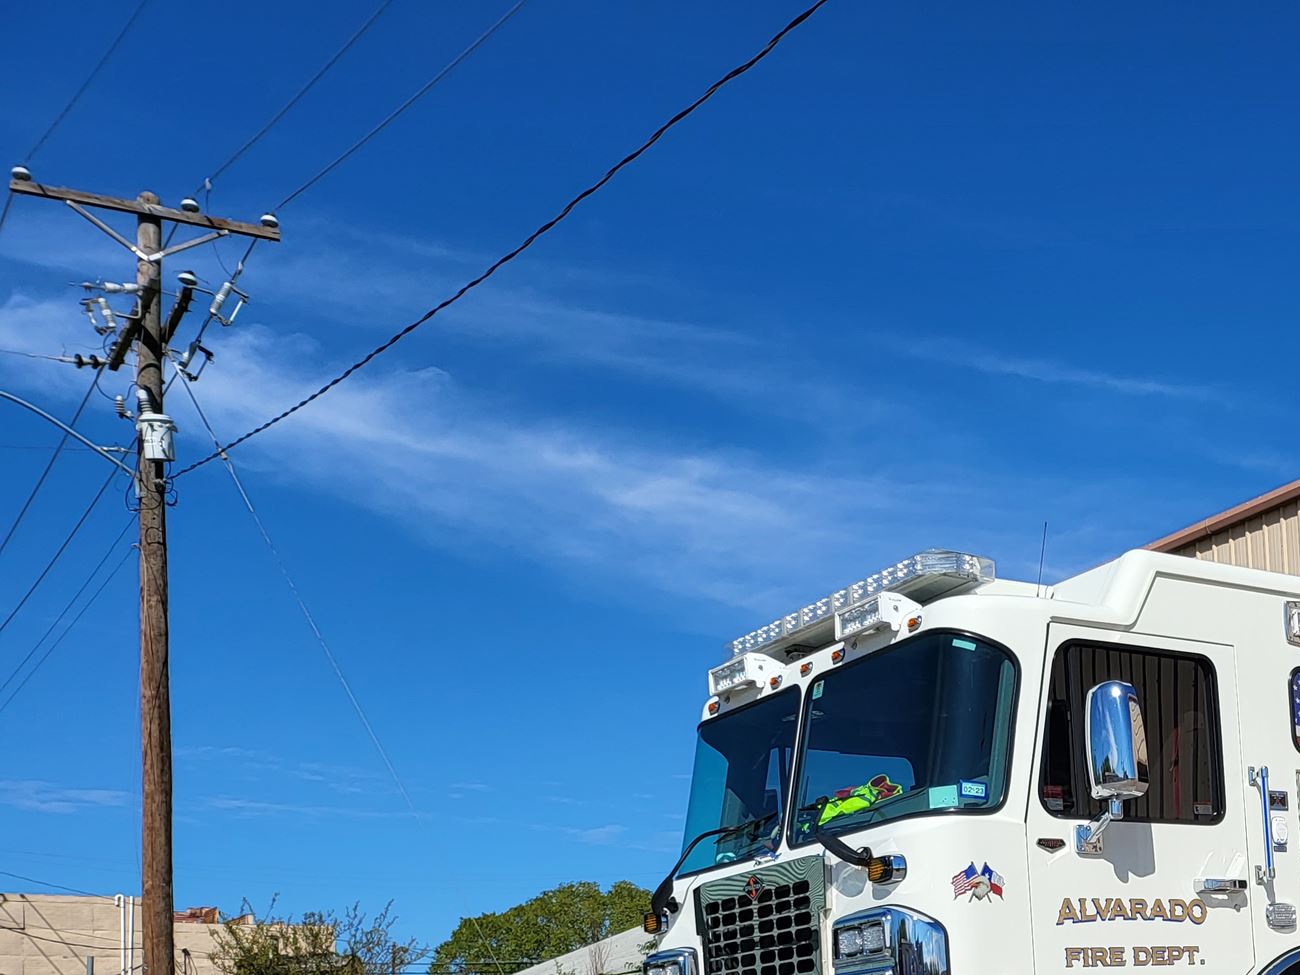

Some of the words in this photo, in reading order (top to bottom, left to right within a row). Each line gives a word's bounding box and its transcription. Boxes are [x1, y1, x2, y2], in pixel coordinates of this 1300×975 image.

[1056, 898, 1208, 925] ALVARADO
[1065, 947, 1126, 968] FIRE
[1133, 946, 1205, 967] DEPT.
